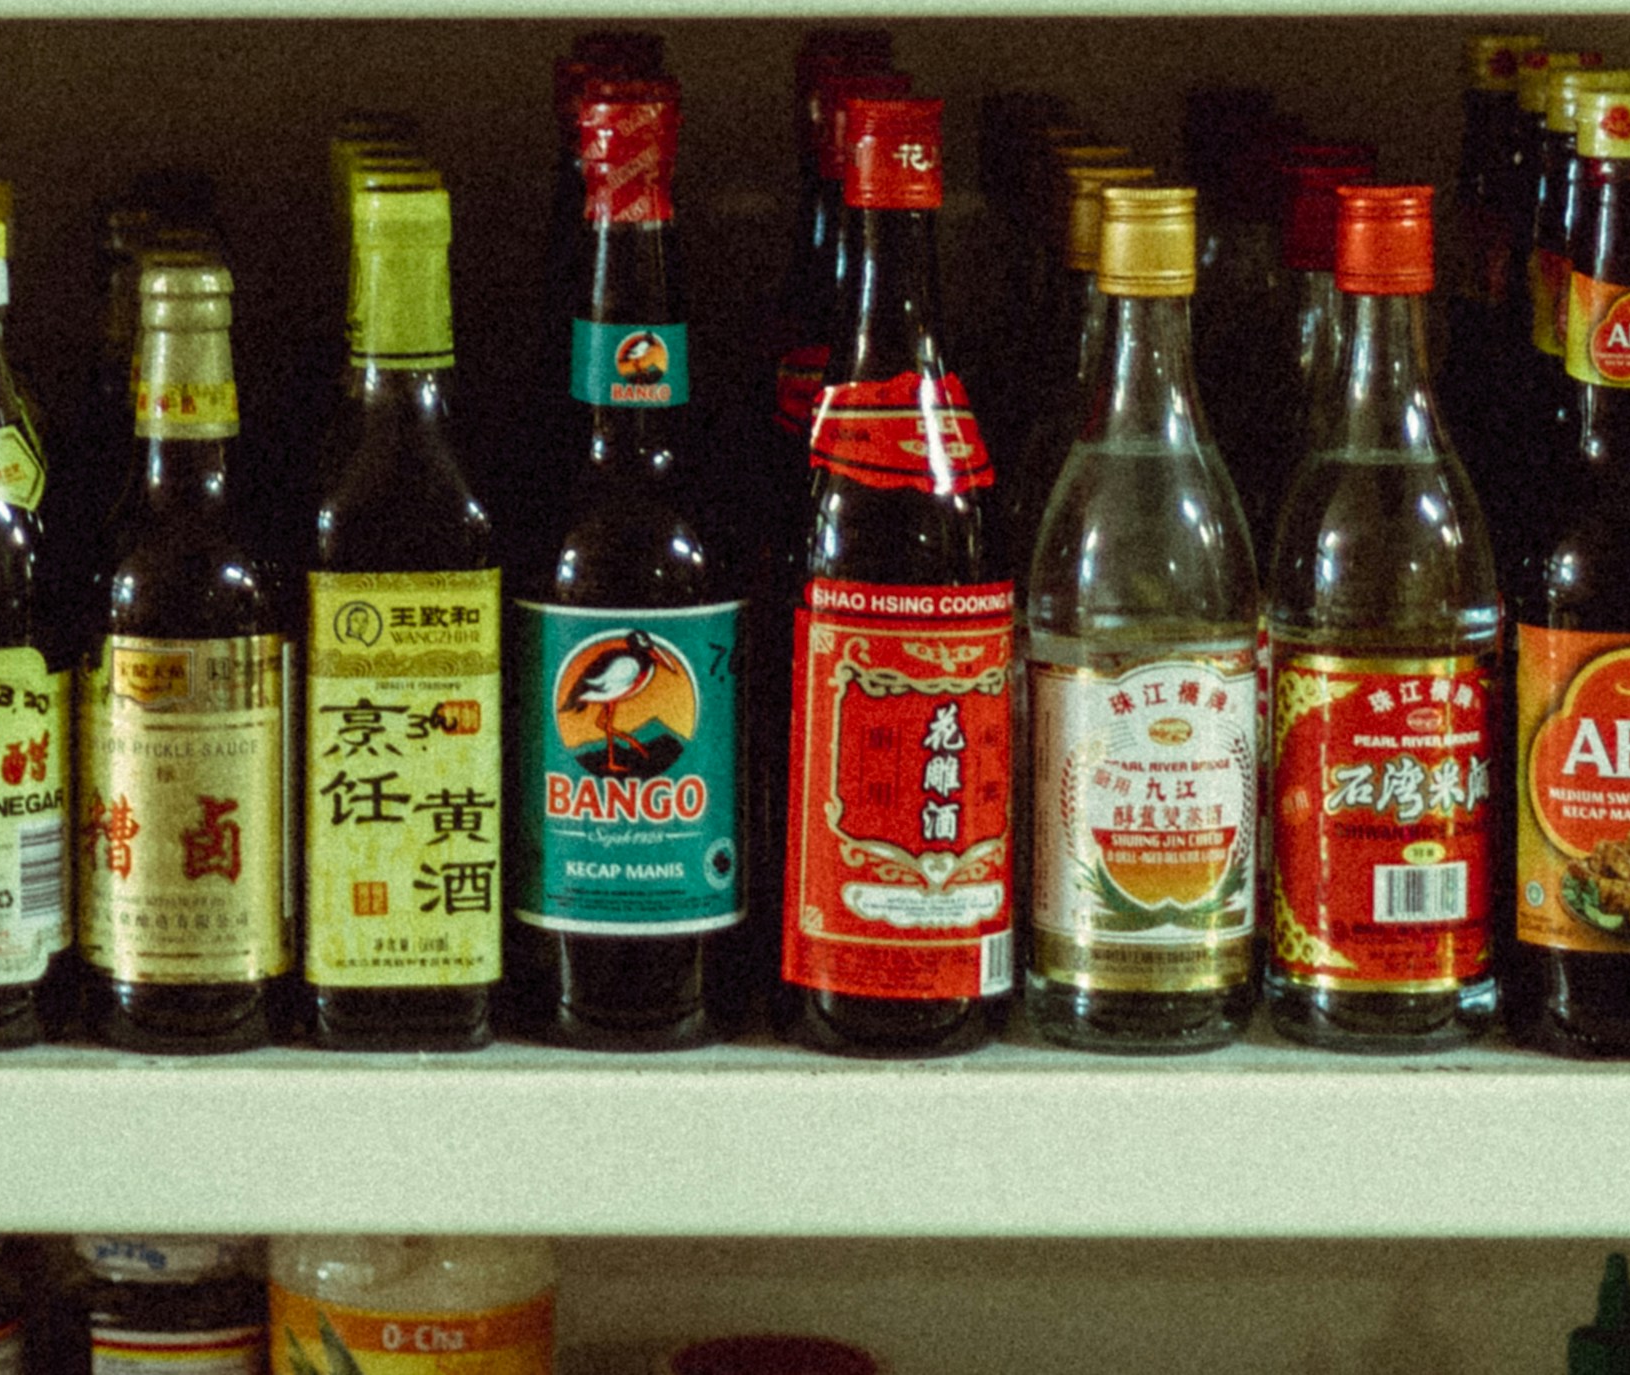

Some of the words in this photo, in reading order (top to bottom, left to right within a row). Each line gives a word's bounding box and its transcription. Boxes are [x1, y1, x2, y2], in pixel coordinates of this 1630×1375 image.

[610, 383, 672, 403] BANGO
[812, 587, 867, 610] SHAO
[871, 592, 936, 614] HSING
[939, 588, 1008, 614] COOKING
[389, 606, 482, 628] 王致和
[132, 739, 195, 760] PICKLE
[200, 738, 259, 759] SAUCE
[1353, 734, 1398, 749] PEARL
[1401, 733, 1441, 748] RIVER
[922, 701, 967, 843] 花雕酒
[1149, 760, 1189, 774] RIVER
[543, 771, 708, 825] BANGO
[1145, 776, 1198, 803] 九江
[1548, 786, 1605, 805] MEDIUM
[1561, 804, 1606, 822] KECAP
[411, 786, 498, 917] 黄酒
[565, 860, 622, 881] KECAP
[625, 860, 685, 881] MANIS
